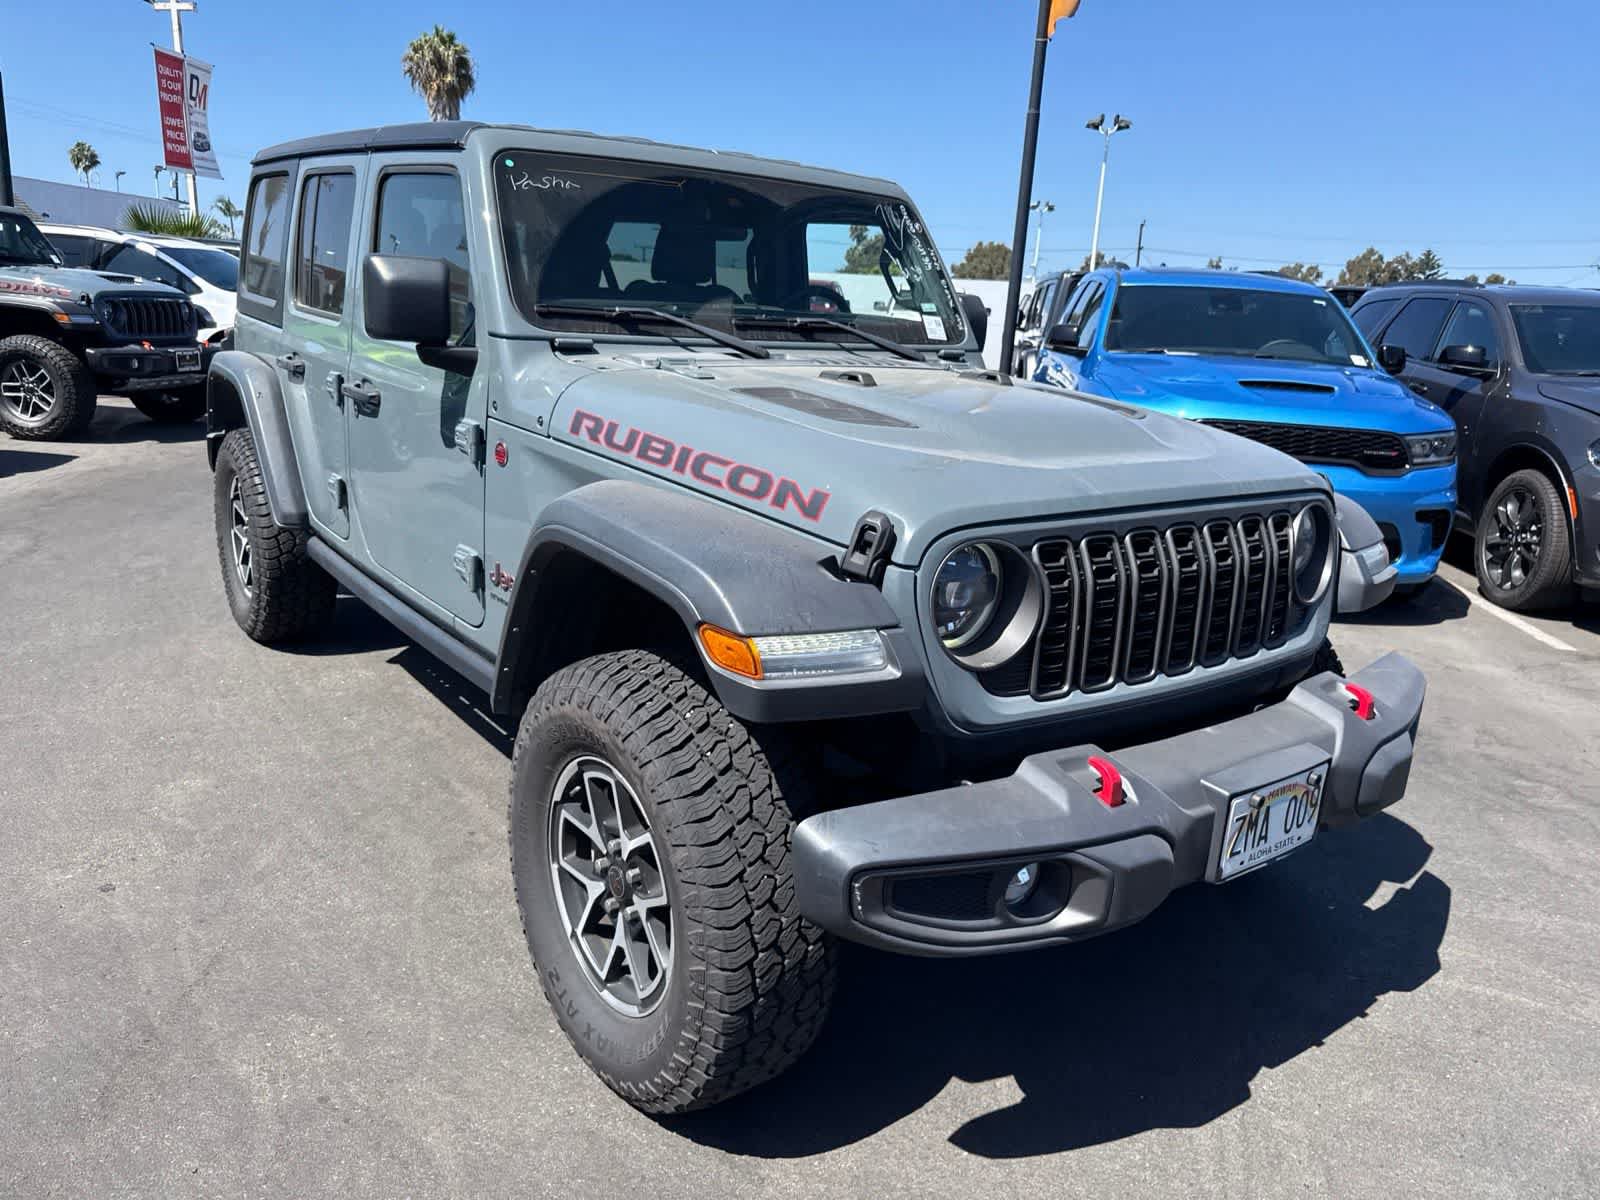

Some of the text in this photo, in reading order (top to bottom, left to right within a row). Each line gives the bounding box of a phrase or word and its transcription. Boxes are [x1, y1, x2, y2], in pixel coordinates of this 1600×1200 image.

[568, 407, 832, 523] RUBICON
[1228, 785, 1321, 858] ZMA 009
[1247, 835, 1295, 863] ALOHA STATE
